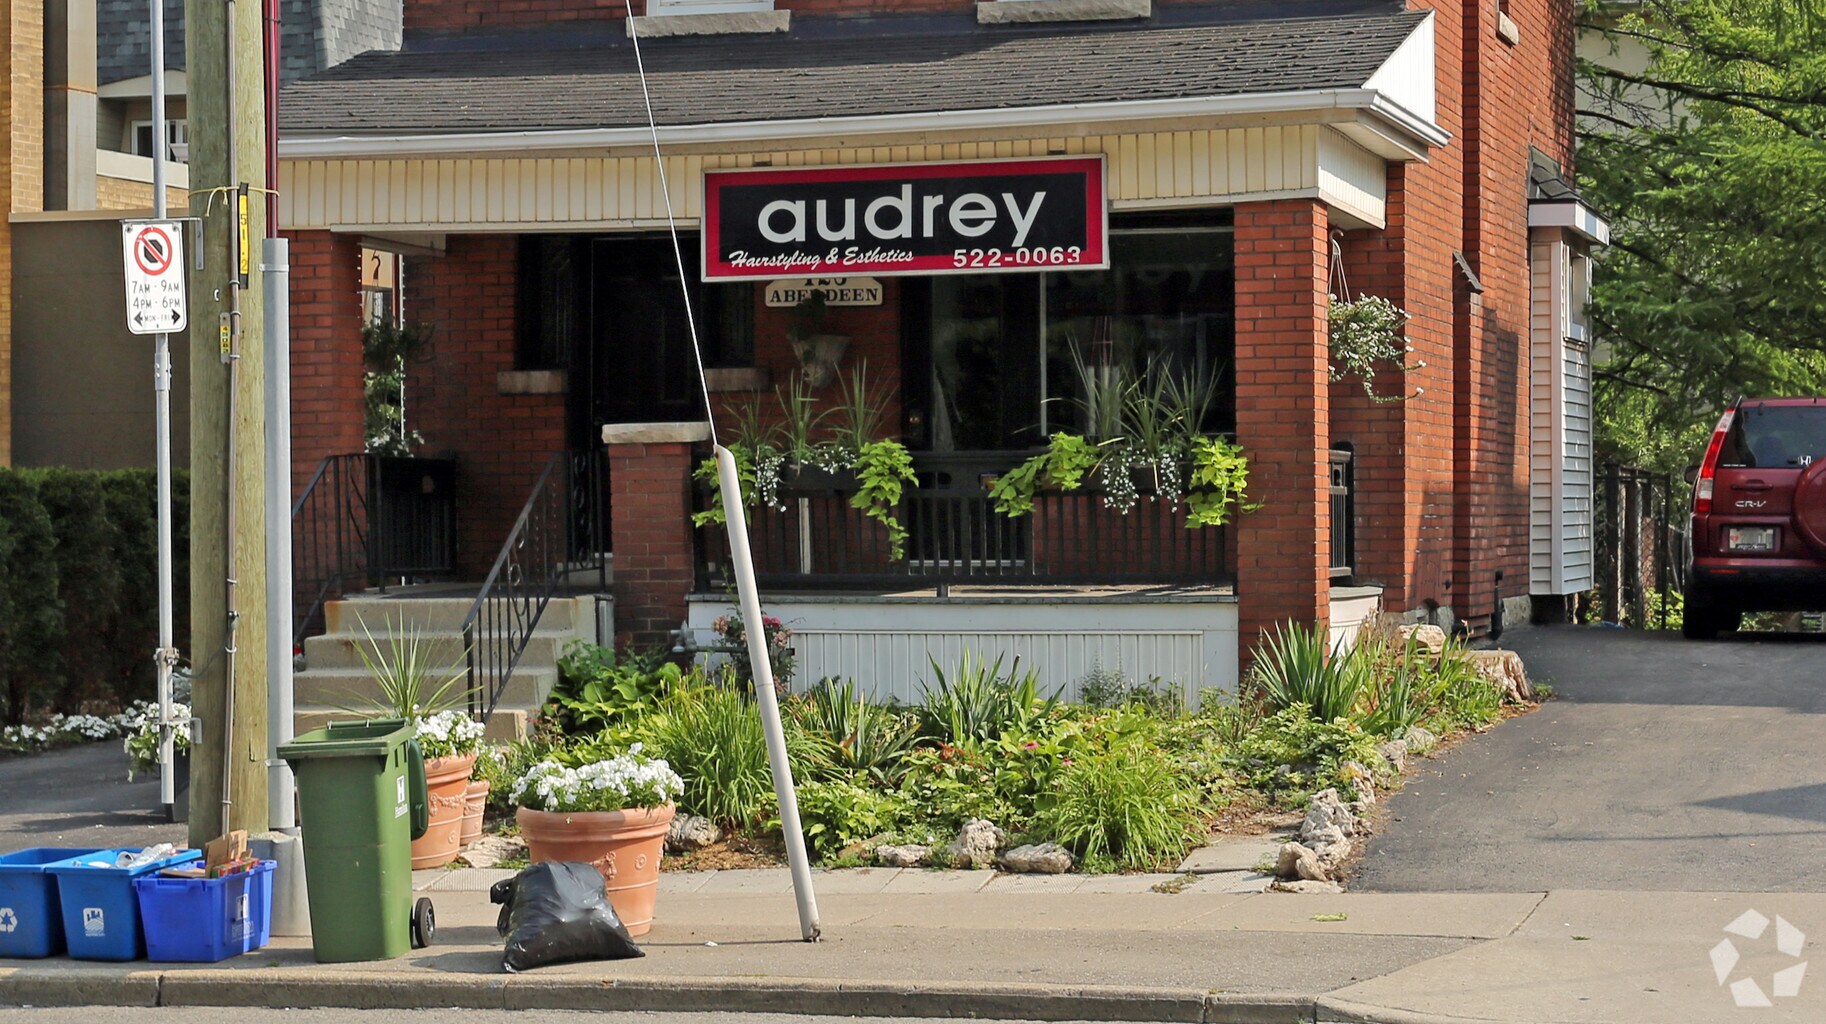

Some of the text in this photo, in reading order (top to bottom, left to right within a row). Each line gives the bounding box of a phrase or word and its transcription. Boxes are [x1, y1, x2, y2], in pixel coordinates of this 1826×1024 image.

[758, 183, 1047, 247] audrey
[729, 246, 914, 271] Hairstyling & Esthetics
[953, 246, 1081, 268] 522-0063
[132, 280, 151, 294] 7AM
[161, 279, 179, 293] 9AM
[133, 296, 152, 310] 4PM
[162, 296, 180, 309] 6PM
[770, 288, 878, 303] ABEDEEN
[1735, 500, 1767, 508] CR-V
